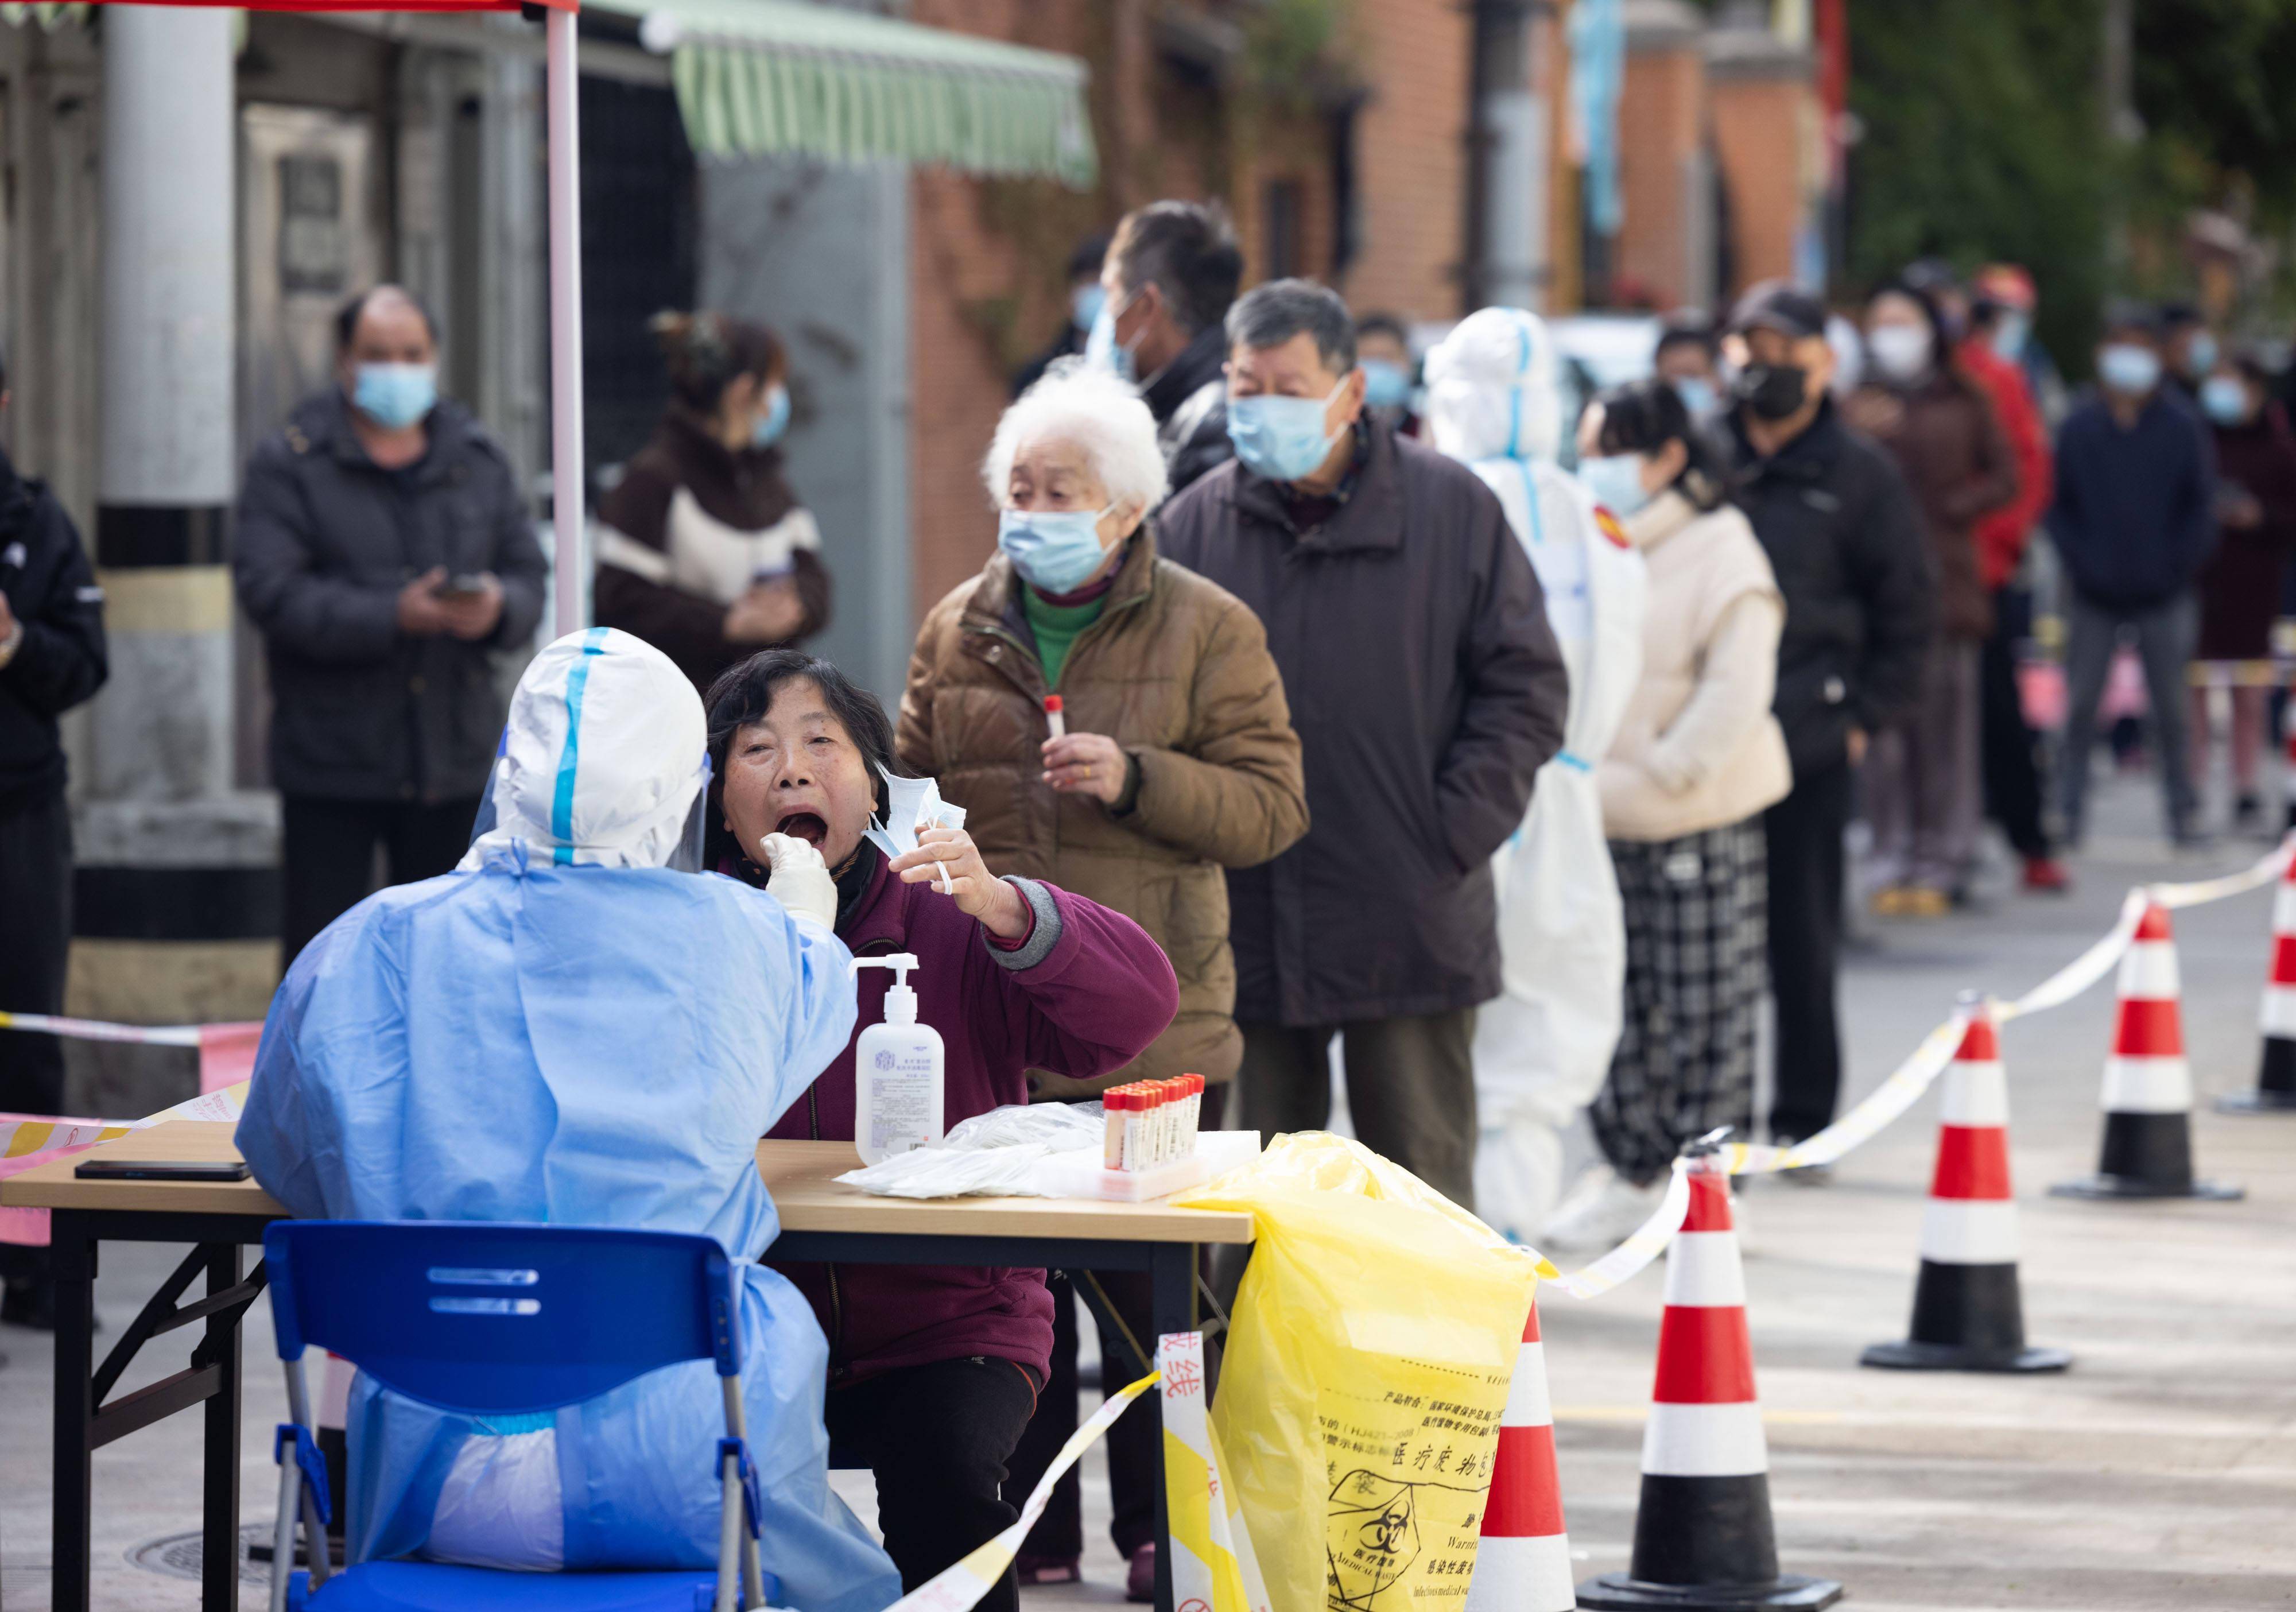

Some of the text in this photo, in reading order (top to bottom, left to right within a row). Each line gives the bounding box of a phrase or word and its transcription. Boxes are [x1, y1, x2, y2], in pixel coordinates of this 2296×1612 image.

[1393, 1442, 1496, 1478] 医疗废物包
